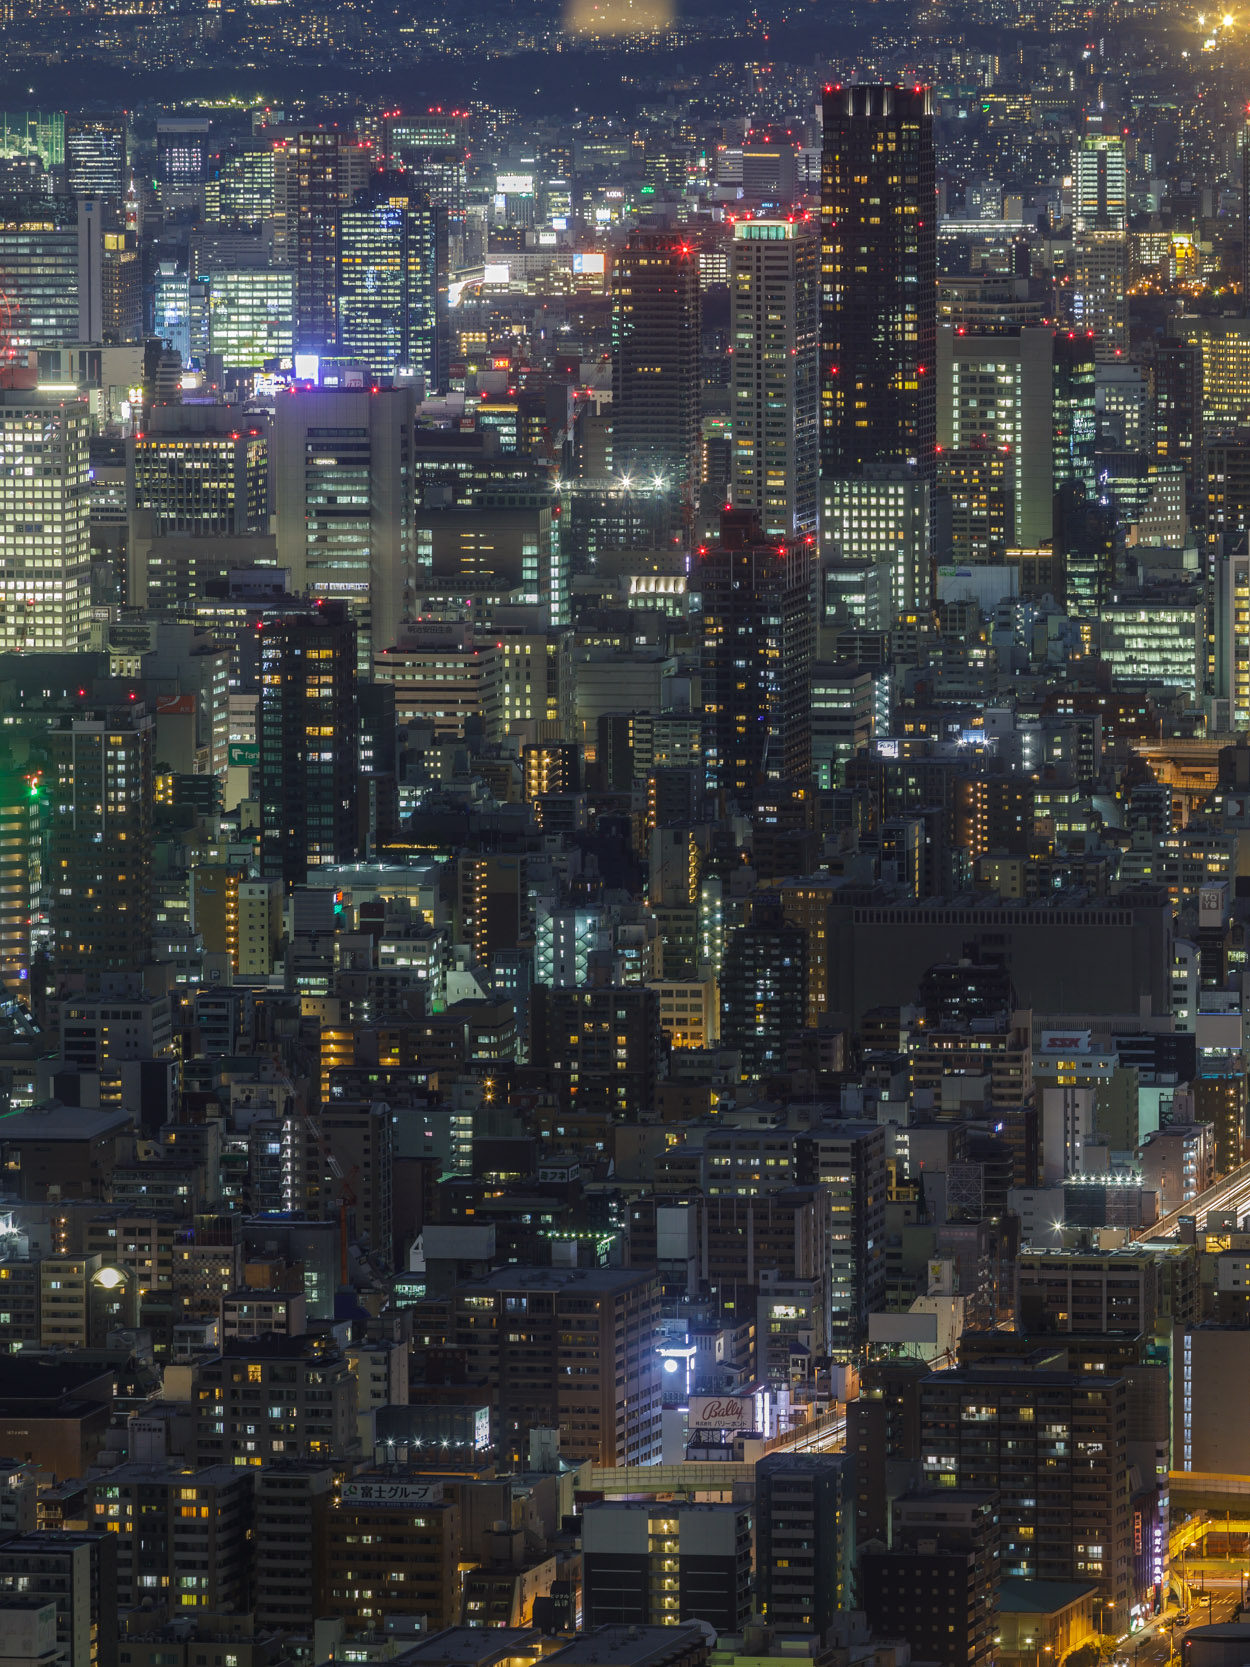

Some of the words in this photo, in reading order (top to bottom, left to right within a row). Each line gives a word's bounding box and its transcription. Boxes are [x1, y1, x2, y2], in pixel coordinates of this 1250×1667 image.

[1047, 1037, 1081, 1048] SSK
[702, 1399, 744, 1421] Bally
[361, 1486, 430, 1499] 富士グループ
